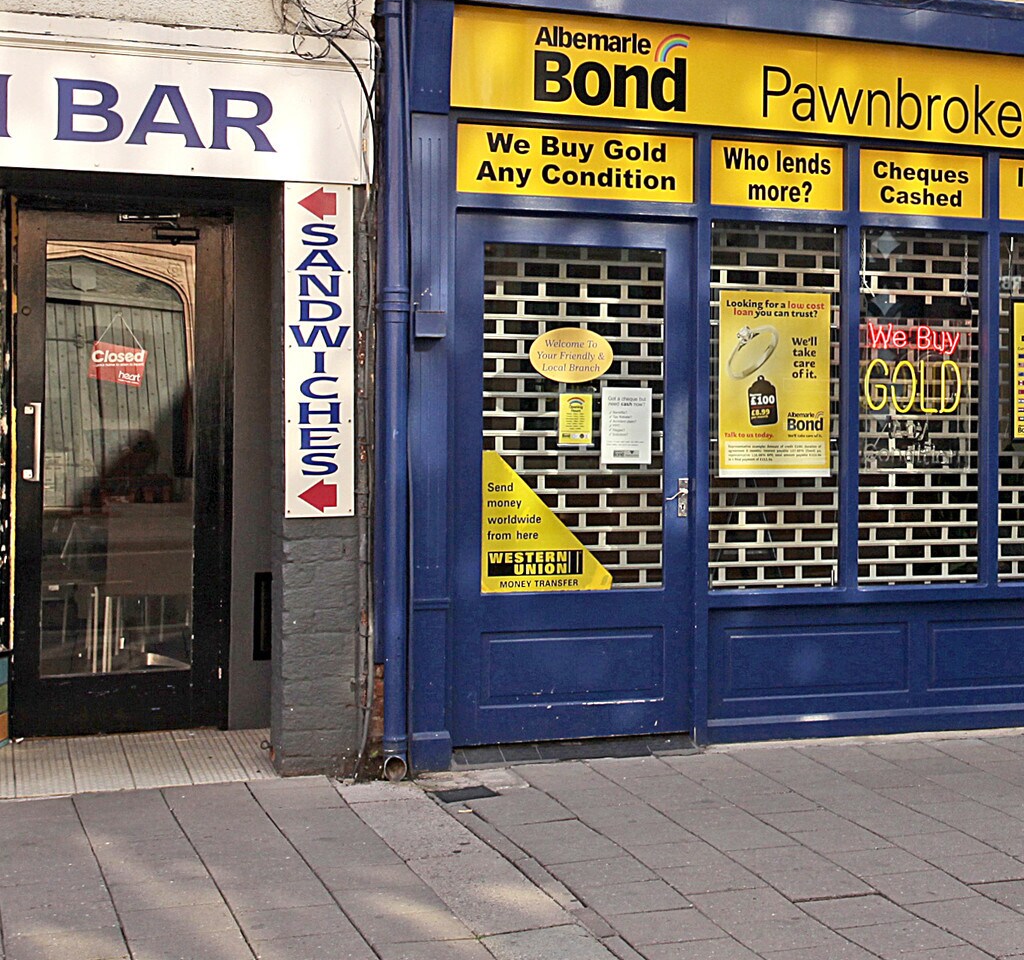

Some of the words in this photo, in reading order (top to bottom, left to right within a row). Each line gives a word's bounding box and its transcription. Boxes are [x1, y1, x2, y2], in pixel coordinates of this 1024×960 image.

[534, 25, 651, 56] Albemarle
[533, 49, 687, 112] Bond
[55, 77, 277, 153] BAR
[486, 132, 530, 155] We
[541, 136, 594, 163] Buy
[603, 139, 667, 163] Gold
[723, 146, 769, 172] Who
[776, 150, 831, 175] lends
[476, 160, 532, 188] Any
[541, 164, 676, 191] Condition
[873, 160, 969, 186] Cheques
[748, 181, 813, 203] more?
[880, 185, 963, 208] Cashed
[726, 300, 763, 310] Looking
[765, 300, 779, 309] for
[788, 301, 804, 310] low
[806, 302, 825, 310] cost
[733, 308, 753, 316] loan
[754, 310, 772, 318] you
[791, 310, 818, 318] trust?
[545, 339, 584, 349] Welcome
[587, 340, 598, 349] To
[792, 336, 817, 346] We'll
[868, 322, 907, 349] We
[917, 326, 960, 354] Buy
[289, 223, 350, 477] SANDWICHES
[793, 348, 816, 357] take
[92, 350, 145, 363] Closed
[537, 351, 557, 361] Your
[560, 351, 595, 362] Friendly
[598, 352, 605, 360] &
[542, 363, 566, 372] Local
[569, 363, 600, 372] Branch
[793, 360, 815, 368] care
[118, 370, 141, 382] heart
[792, 369, 804, 379] of
[806, 369, 817, 379] it.
[864, 358, 961, 413] GOLD
[750, 395, 775, 406] £100
[787, 417, 823, 431] Bond
[755, 432, 774, 441] today.
[487, 482, 514, 492] Send
[487, 500, 522, 508] money
[487, 515, 542, 525] worldwide
[487, 531, 511, 540] from
[516, 531, 539, 540] here
[489, 551, 567, 563] WESTERN
[514, 563, 567, 575] UNION
[500, 580, 531, 588] MONEY
[535, 579, 578, 588] TRANSFER
